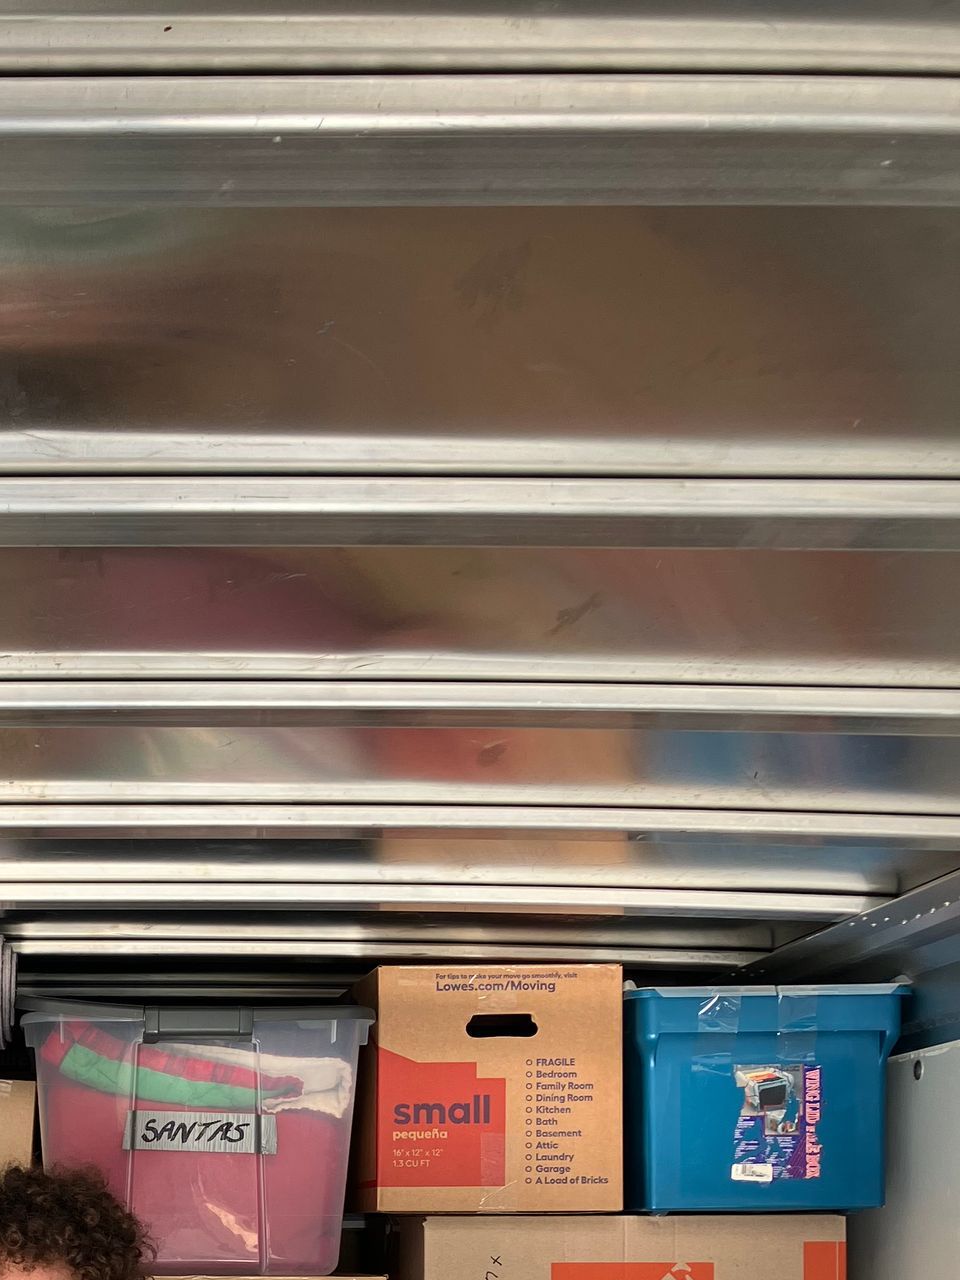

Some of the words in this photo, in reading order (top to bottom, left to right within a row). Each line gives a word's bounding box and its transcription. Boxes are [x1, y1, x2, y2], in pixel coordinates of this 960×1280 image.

[447, 973, 459, 981] tips
[436, 980, 556, 993] Lowes.com/Moving
[536, 1058, 576, 1067] FRAGILE
[536, 1070, 577, 1079] Bedroom
[536, 1082, 566, 1092] Family
[568, 1082, 594, 1090] Room
[536, 1093, 566, 1104] Dining
[567, 1094, 593, 1102] Room
[393, 1094, 490, 1125] small
[536, 1105, 571, 1114] Kitchen
[536, 1117, 558, 1126] Bath
[141, 1118, 250, 1144] SANTAS
[392, 1128, 448, 1141] pequeña
[536, 1129, 582, 1138] Basement
[535, 1141, 559, 1150] Attic
[535, 1153, 574, 1163] Laundry
[393, 1160, 404, 1168] 1.3
[406, 1160, 419, 1168] CU
[420, 1160, 430, 1168] FT
[535, 1165, 571, 1175] Garage
[535, 1177, 543, 1185] A
[544, 1176, 568, 1185] Load
[570, 1176, 580, 1185] of
[581, 1176, 609, 1185] Bricks
